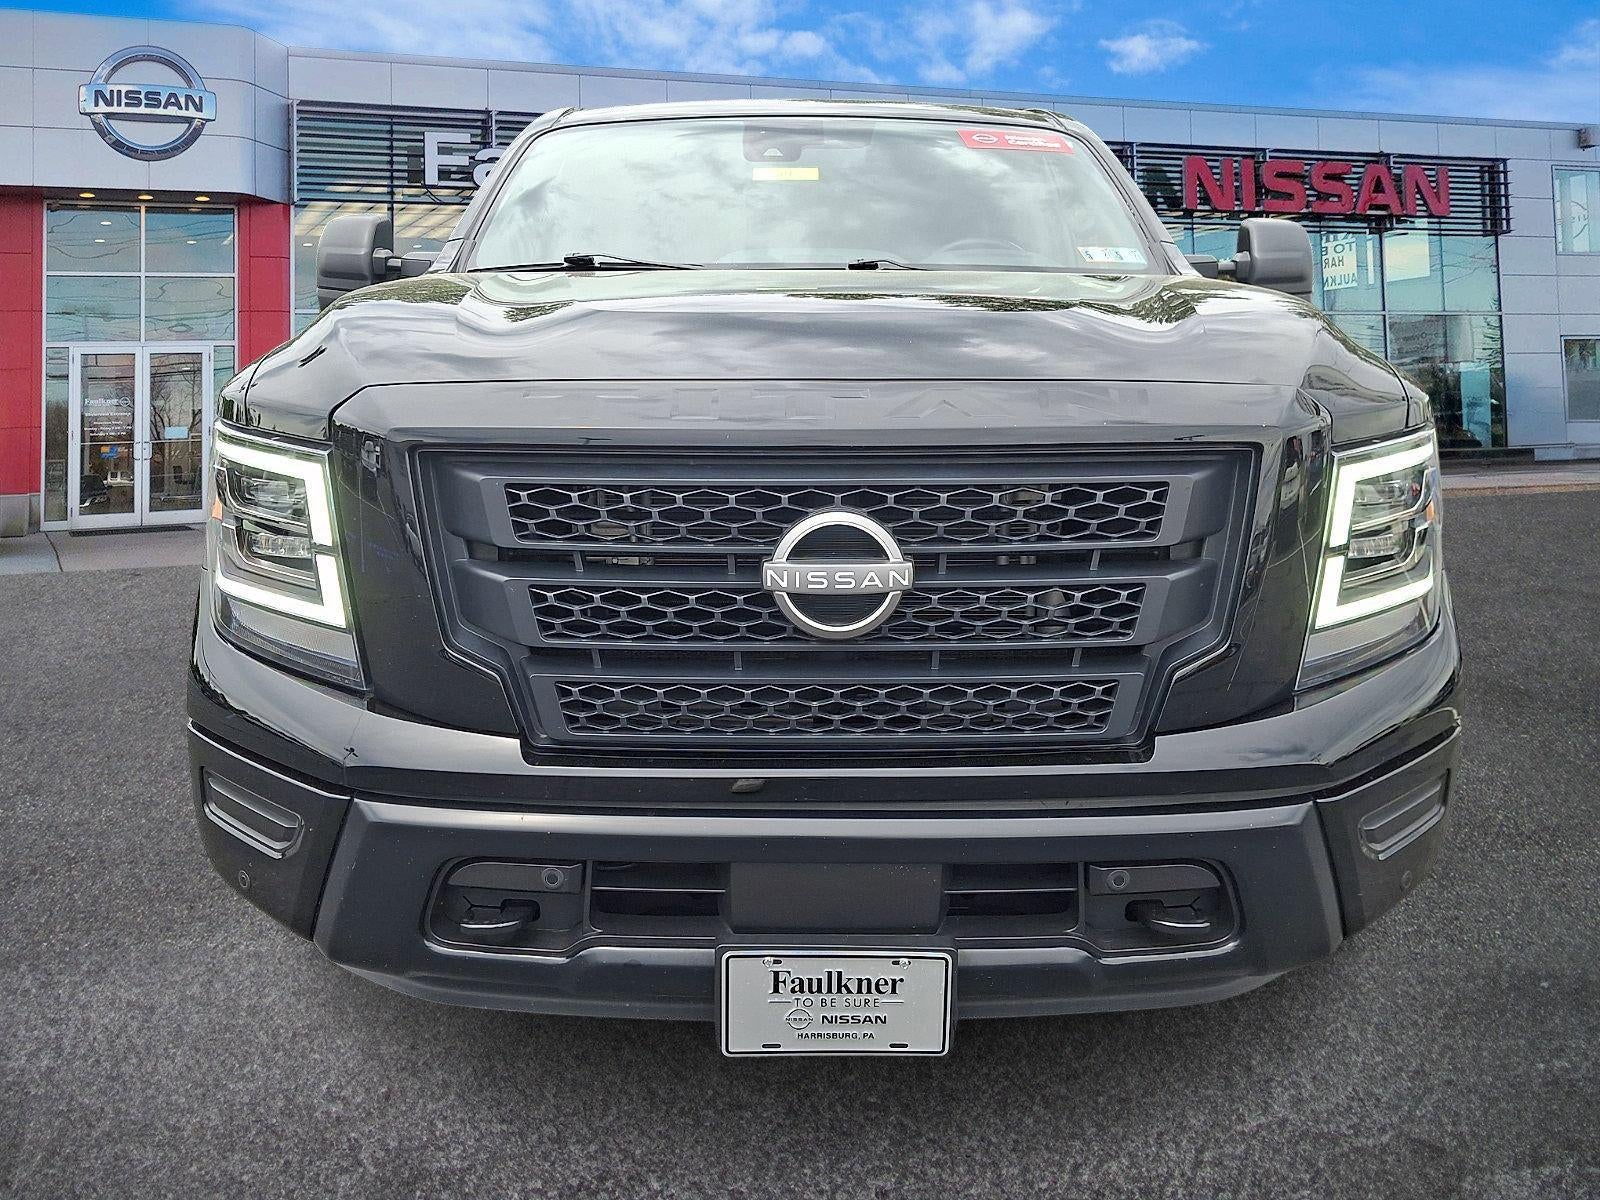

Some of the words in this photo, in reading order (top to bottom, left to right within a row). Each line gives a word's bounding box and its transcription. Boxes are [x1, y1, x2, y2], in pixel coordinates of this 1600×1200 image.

[93, 89, 204, 113] NISSAN
[1182, 155, 1450, 217] NISSAN
[766, 569, 910, 589] NISSAN
[768, 970, 905, 995] Faulkner
[794, 998, 814, 1008] TO
[821, 998, 837, 1008] BE
[845, 998, 881, 1008] SURE
[821, 1015, 887, 1025] NISSAN
[797, 1032, 861, 1040] HARRISBURG,
[863, 1032, 875, 1040] PA
